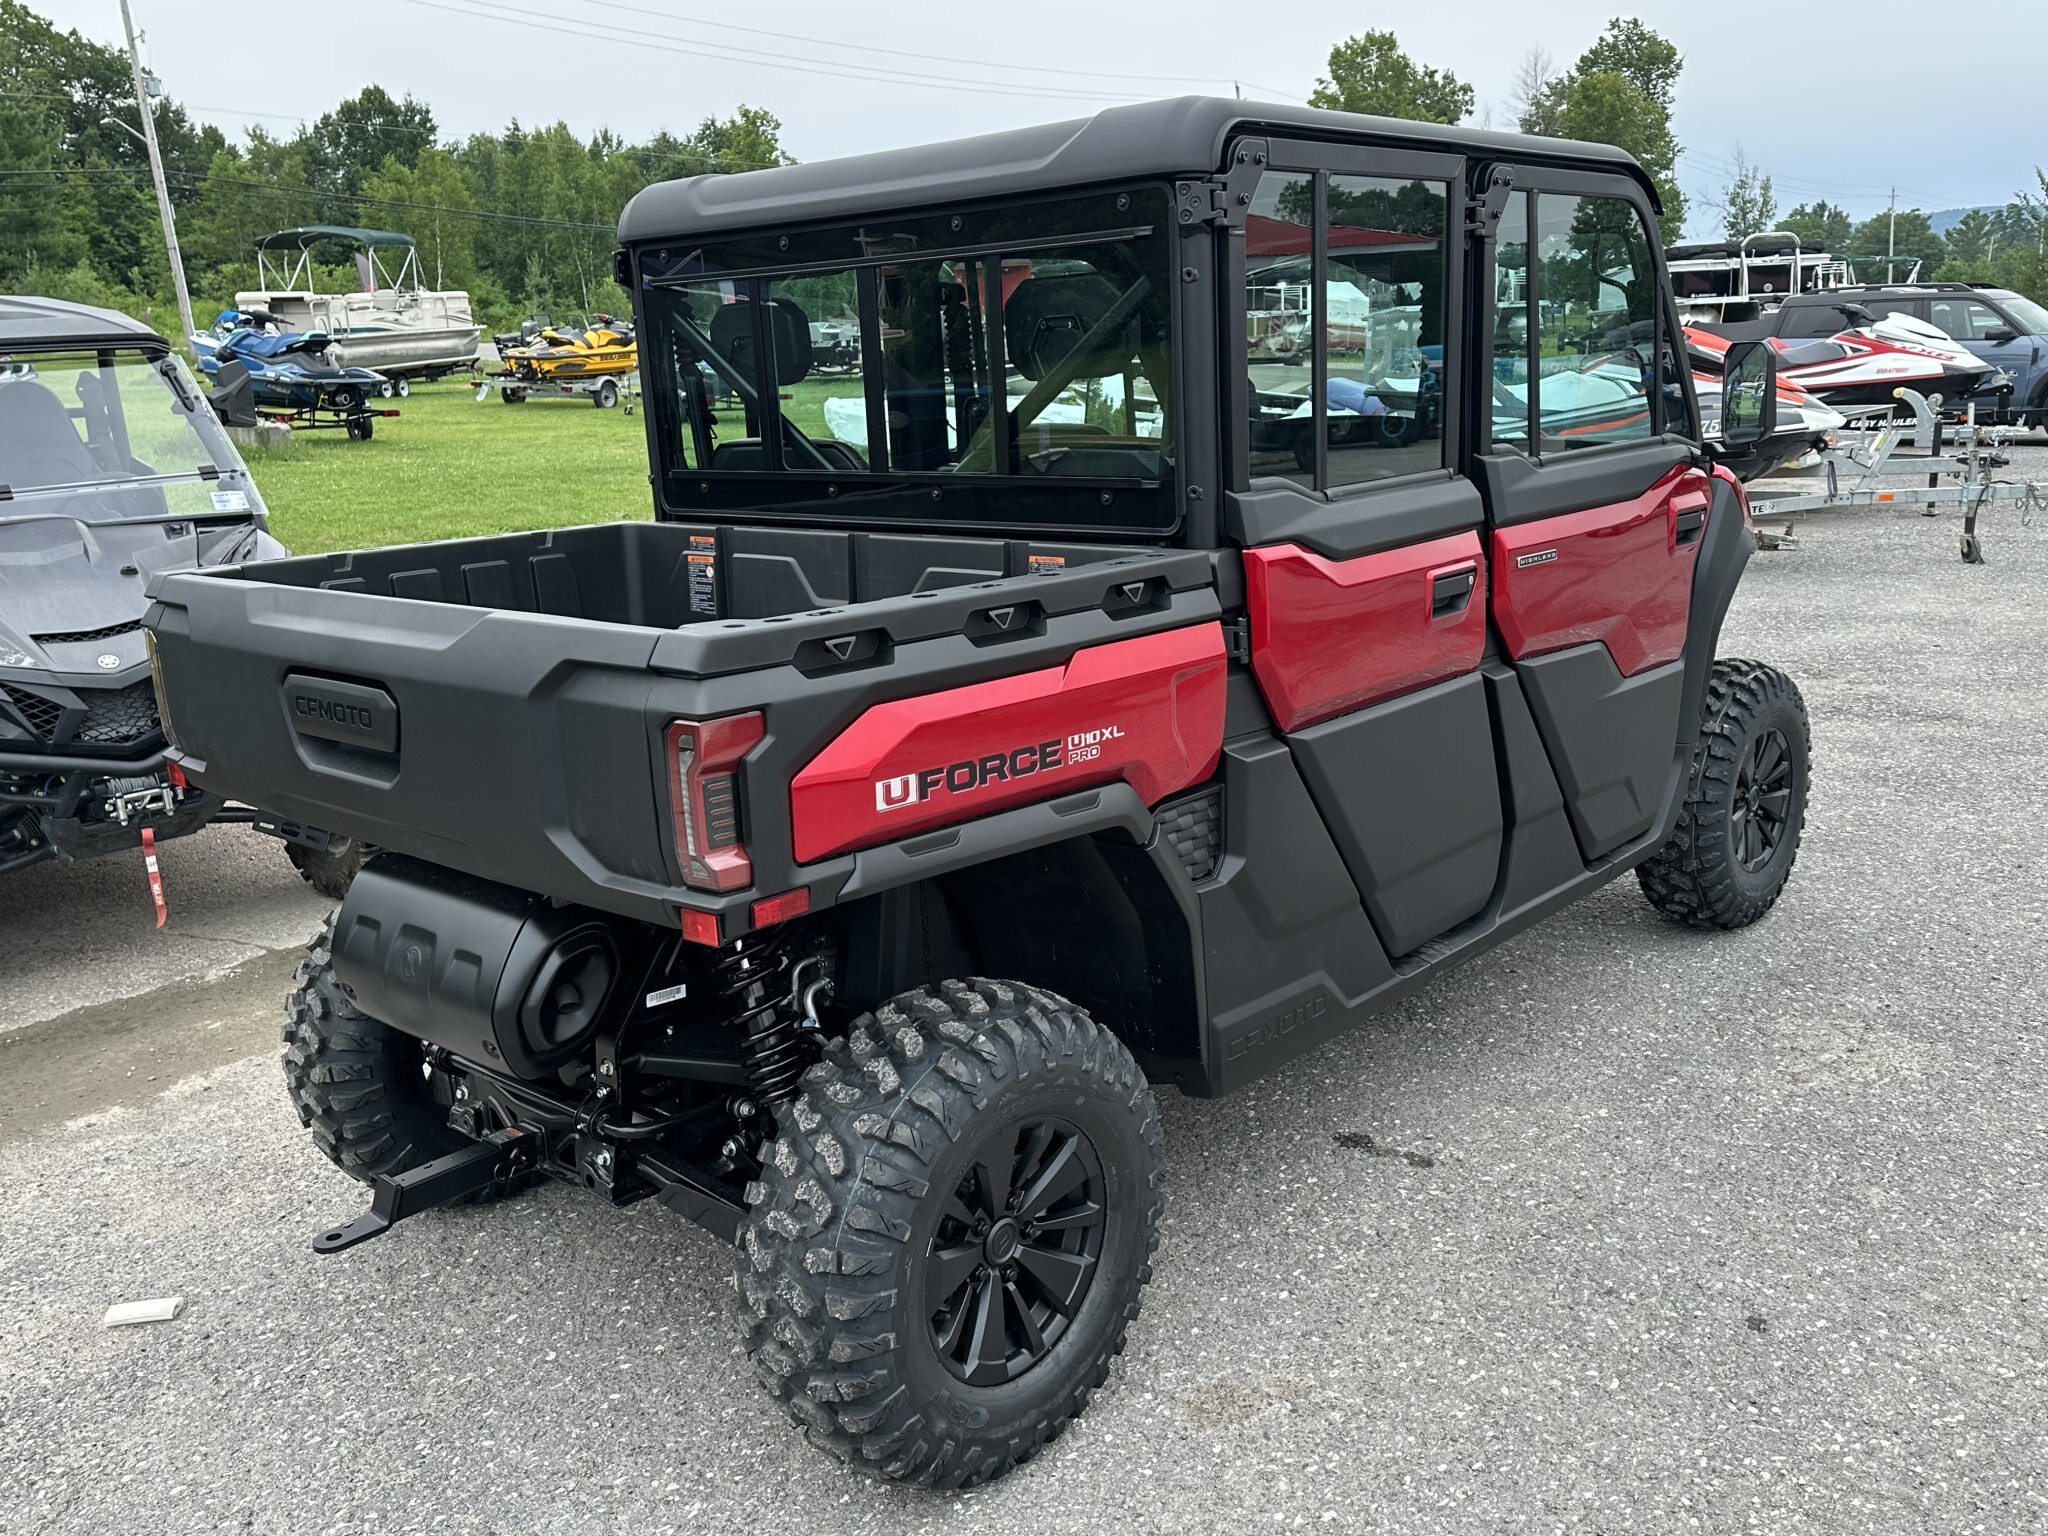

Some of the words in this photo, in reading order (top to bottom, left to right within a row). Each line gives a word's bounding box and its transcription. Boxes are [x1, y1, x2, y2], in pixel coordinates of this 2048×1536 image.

[1878, 418, 1918, 427] HULER
[1520, 552, 1556, 564] HIGHLAND
[295, 695, 373, 730] CFMOTO
[1068, 745, 1101, 765] PRO
[1226, 993, 1328, 1061] CFMOTO
